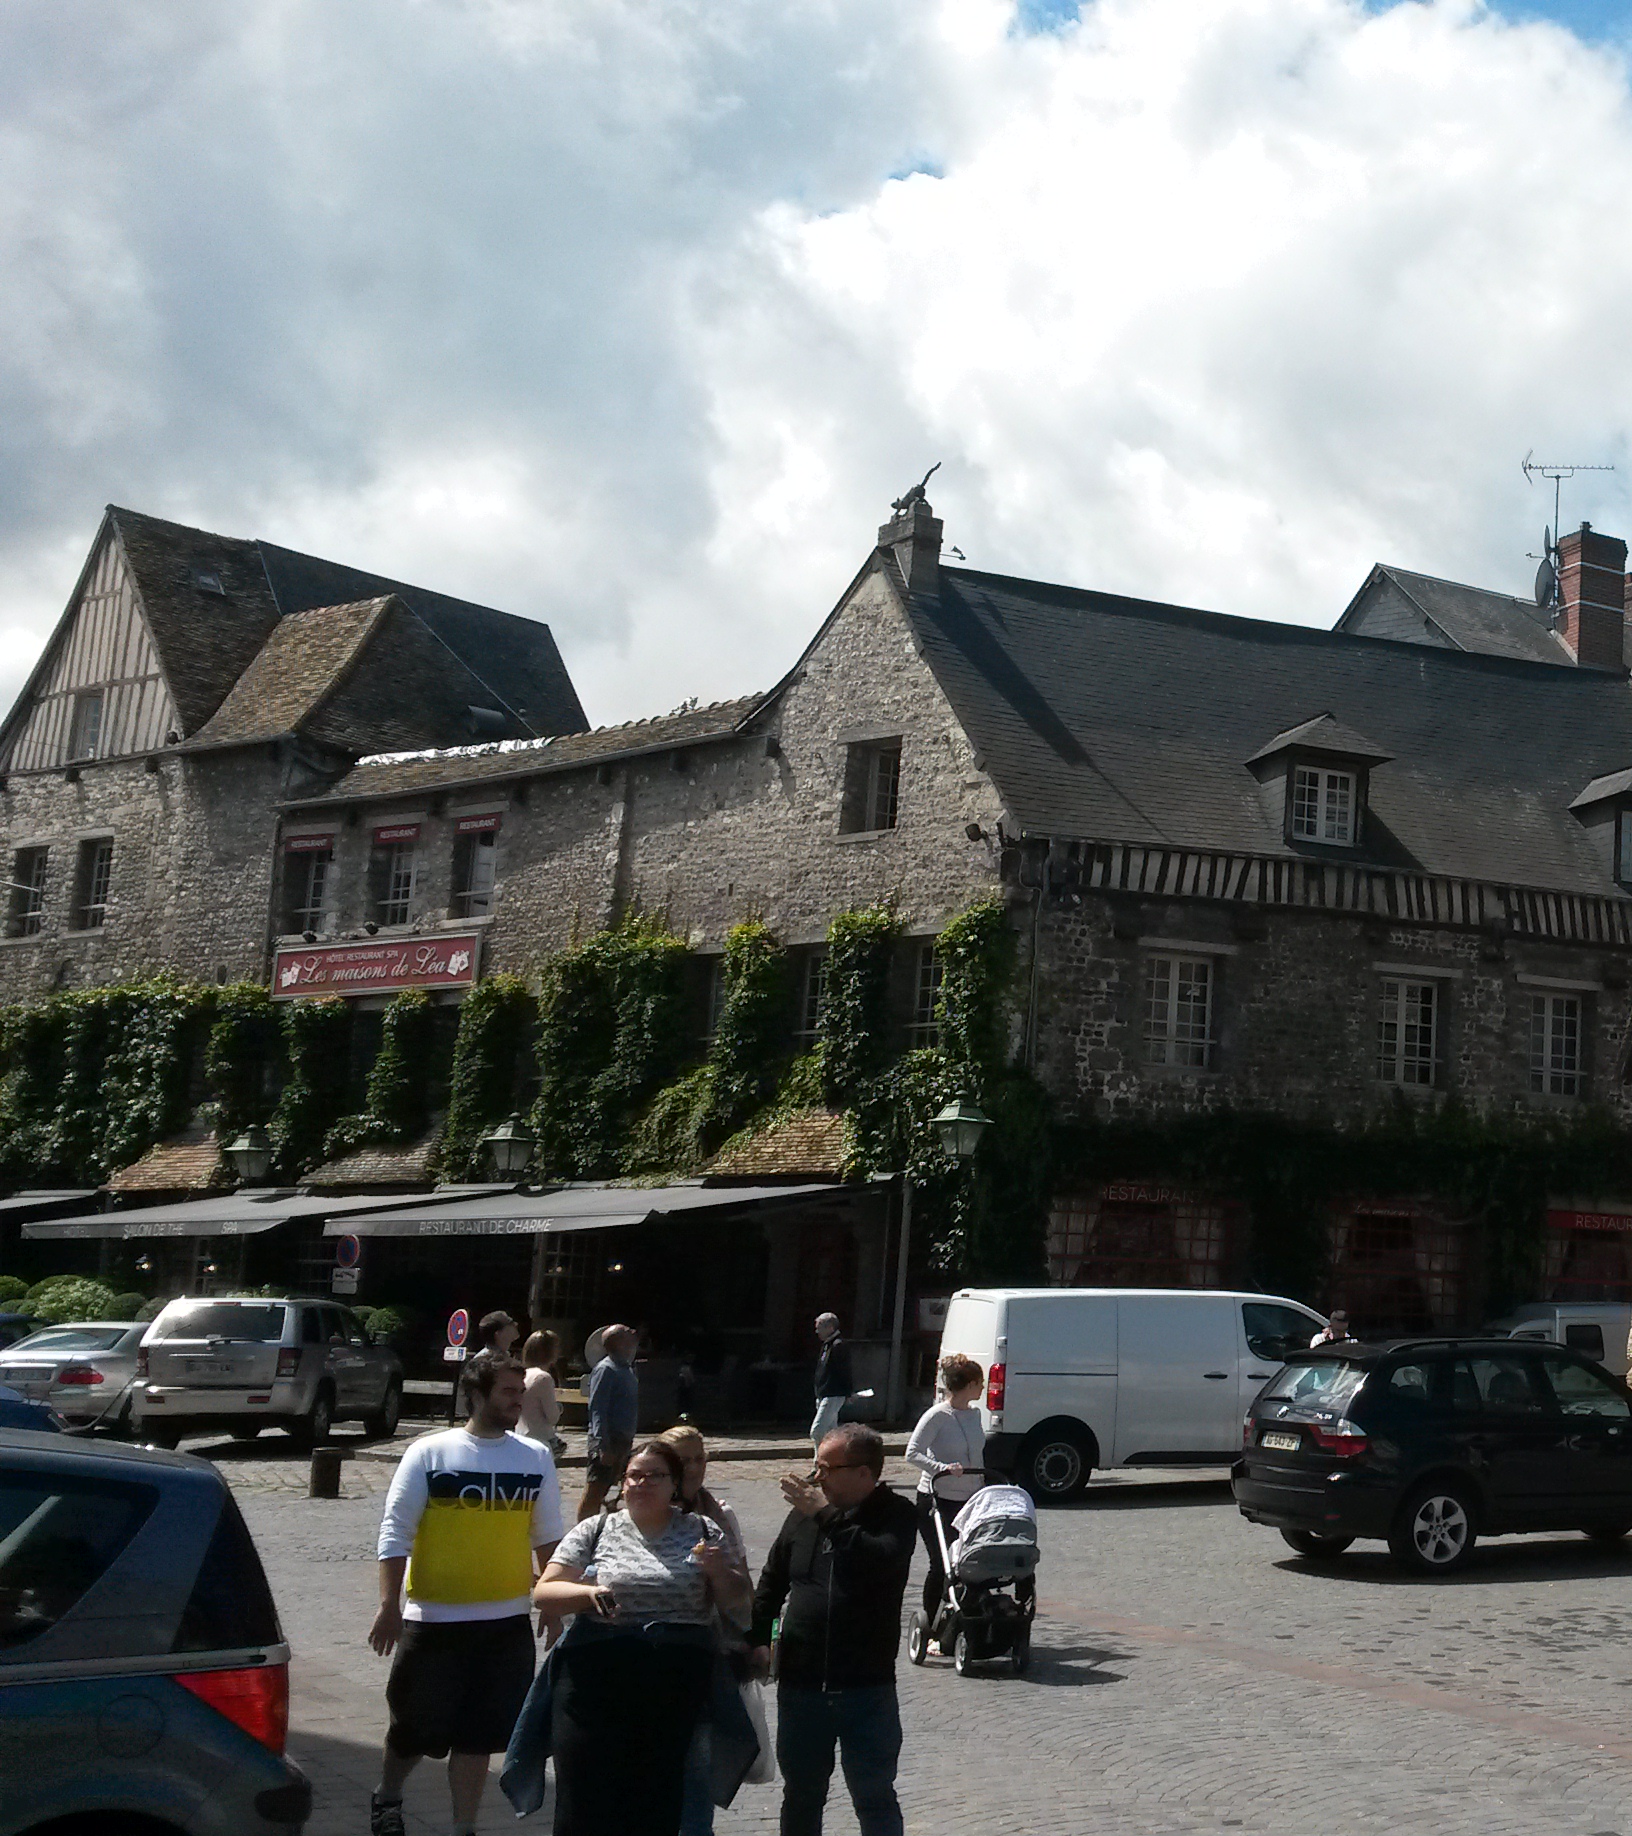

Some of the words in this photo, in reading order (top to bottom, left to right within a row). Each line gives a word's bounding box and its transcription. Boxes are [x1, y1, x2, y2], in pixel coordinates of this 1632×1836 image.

[459, 818, 497, 830] RESTAURANT
[380, 828, 417, 839] RESTAURANT
[291, 839, 328, 848] RESTAURANT
[347, 950, 385, 961] RESTAURANT
[386, 949, 399, 959] SPA
[300, 955, 327, 984] Les
[331, 962, 387, 982] maisons
[390, 952, 409, 977] de
[411, 946, 447, 975] Léa
[153, 1223, 167, 1236] DE
[220, 1221, 239, 1235] SPA
[419, 1220, 487, 1235] RESTAURANT
[489, 1220, 505, 1234] DE
[506, 1218, 555, 1234] CHARME
